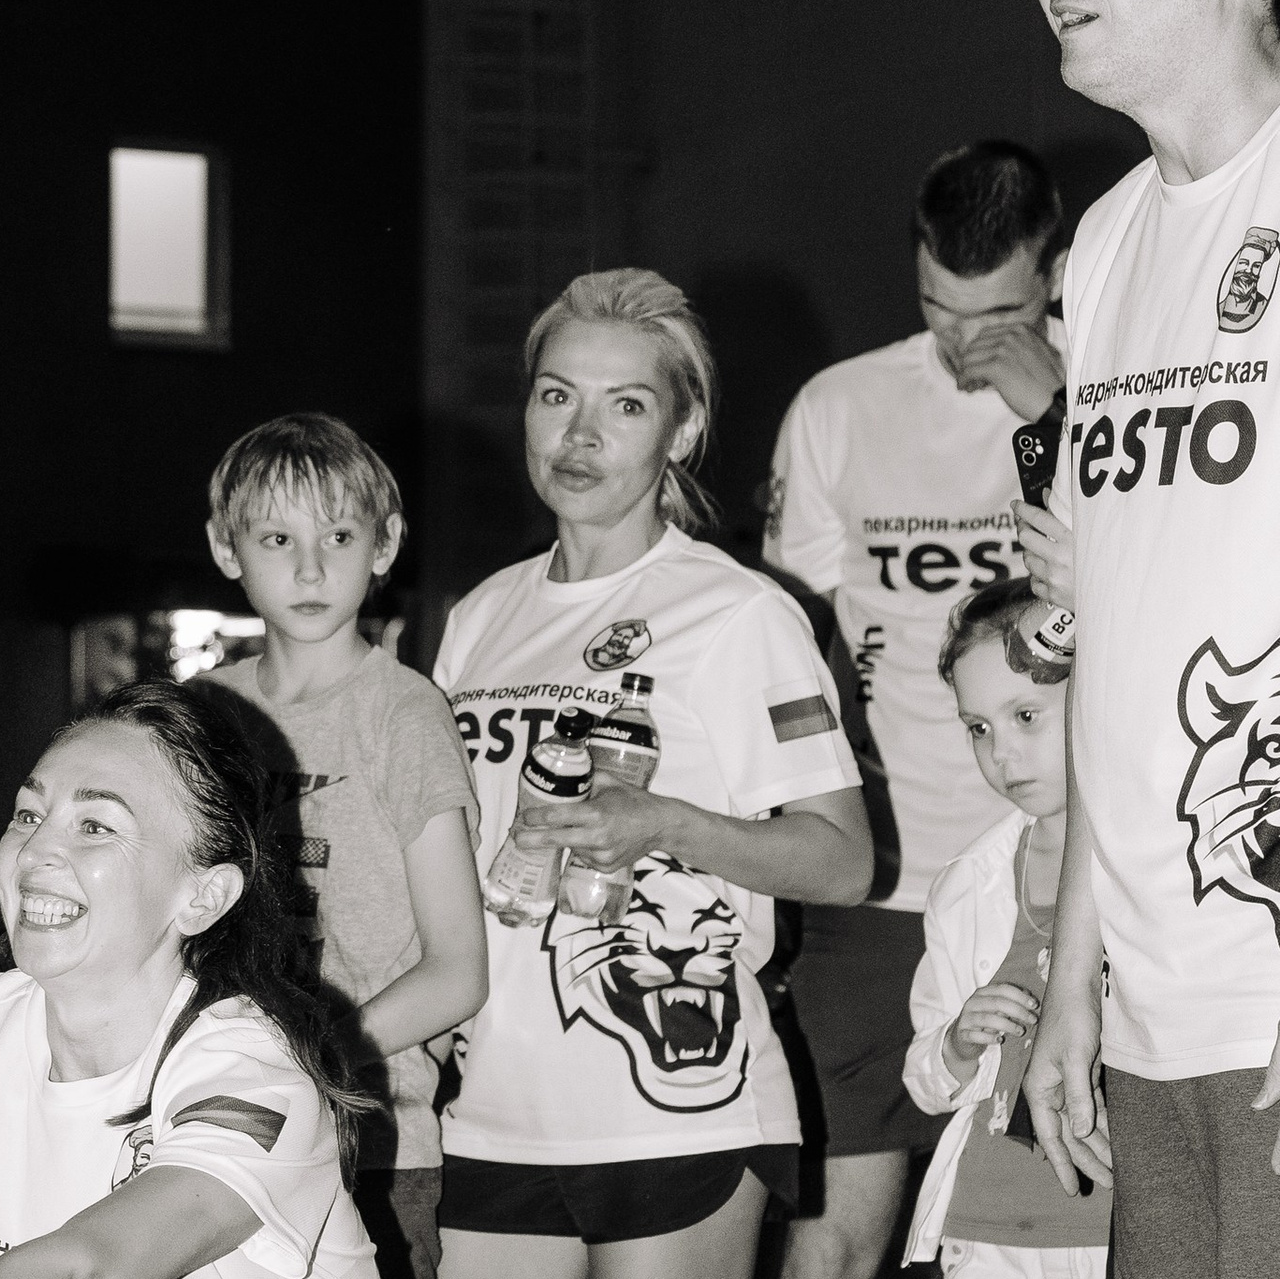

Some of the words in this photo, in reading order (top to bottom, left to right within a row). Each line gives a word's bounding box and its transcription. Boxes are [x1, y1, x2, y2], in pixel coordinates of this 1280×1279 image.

[1075, 360, 1268, 410] карня-кондитерская
[863, 512, 1020, 536] пекарня-конд
[1052, 610, 1076, 634] BC
[450, 683, 623, 707] арня-кондитерская
